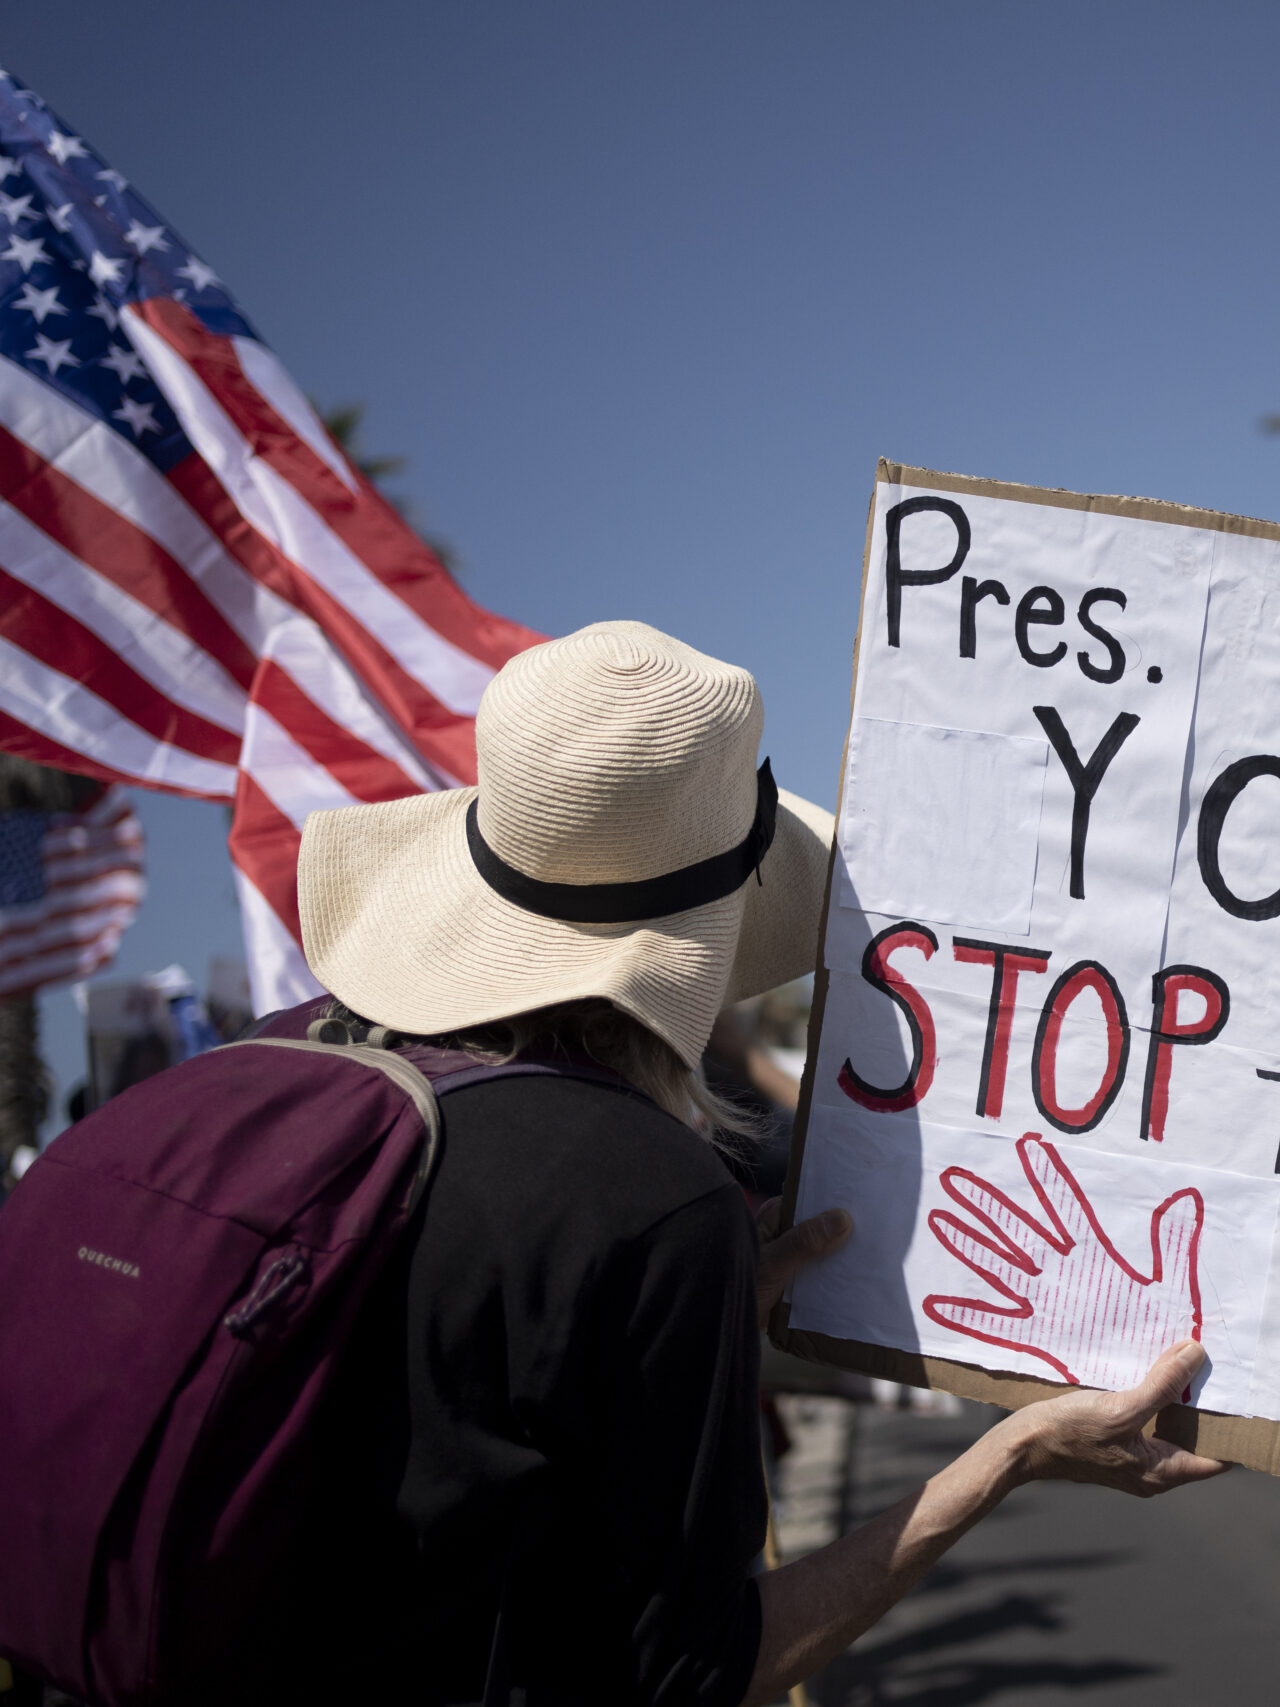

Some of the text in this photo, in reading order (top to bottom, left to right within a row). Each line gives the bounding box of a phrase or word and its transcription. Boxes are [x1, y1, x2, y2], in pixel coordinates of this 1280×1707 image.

[886, 496, 1162, 684] Pres.
[837, 921, 1231, 1142] STOP
[77, 1246, 141, 1279] QUECHUA
